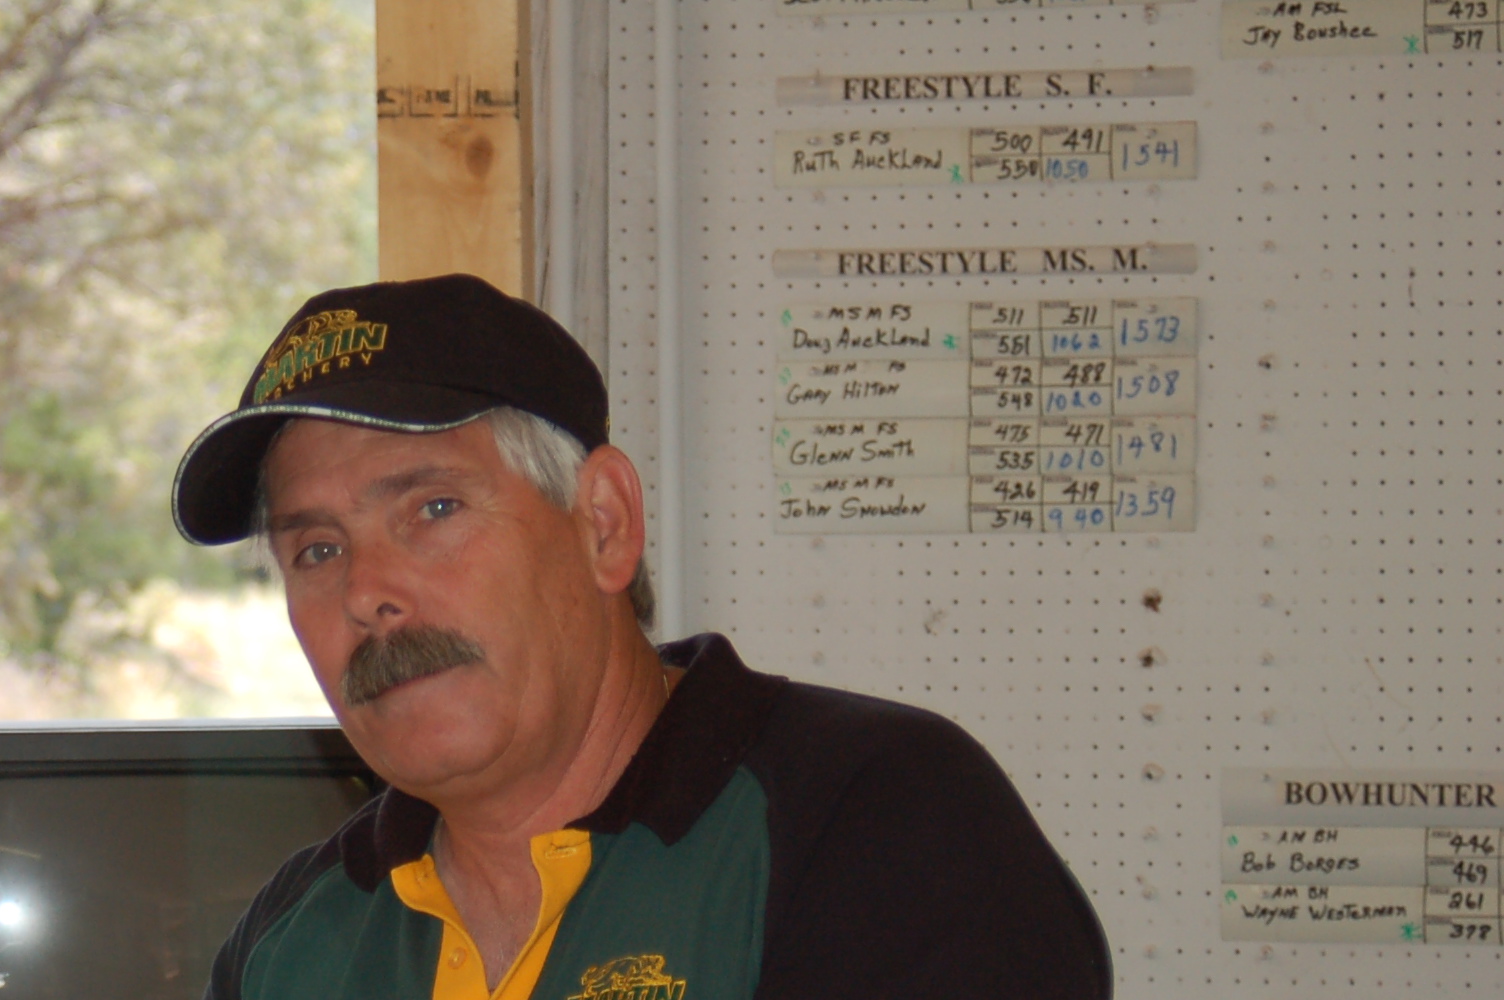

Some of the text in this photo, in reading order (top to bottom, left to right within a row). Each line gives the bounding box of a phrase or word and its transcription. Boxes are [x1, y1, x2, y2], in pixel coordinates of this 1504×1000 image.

[1448, 1, 1488, 19] 473
[1452, 29, 1484, 50] 517
[843, 72, 1113, 101] FREESTYLE S. F.
[992, 131, 1032, 154] 500
[1062, 128, 1103, 153] 491
[1123, 140, 1178, 171] 1541
[997, 159, 1038, 180] 550
[1047, 158, 1089, 180] 1050
[837, 248, 1148, 275] FREESTYLE MS. M.
[993, 307, 1024, 326] 511
[1063, 306, 1097, 327] 511
[1121, 316, 1180, 346] 1573
[1053, 333, 1100, 352] 1062
[253, 321, 388, 405] MARTIN
[995, 366, 1032, 384] 472
[1064, 362, 1106, 387] 488
[1117, 370, 1179, 400] 1508
[997, 392, 1033, 410] 548
[995, 424, 1031, 443] 475
[1064, 423, 1105, 446] 471
[1046, 448, 1105, 470] 1010
[1118, 432, 1177, 465] 1481
[996, 450, 1034, 470] 535
[994, 481, 1036, 503] 426
[1062, 481, 1100, 504] 419
[1116, 486, 1176, 519] 1359
[991, 509, 1033, 529] 514
[1048, 508, 1104, 529] 940
[1284, 781, 1498, 808] BOWHUNTER
[1450, 834, 1494, 855] 446
[1241, 852, 1276, 873] Bob
[1453, 860, 1487, 885] 469
[1448, 891, 1484, 910] 261
